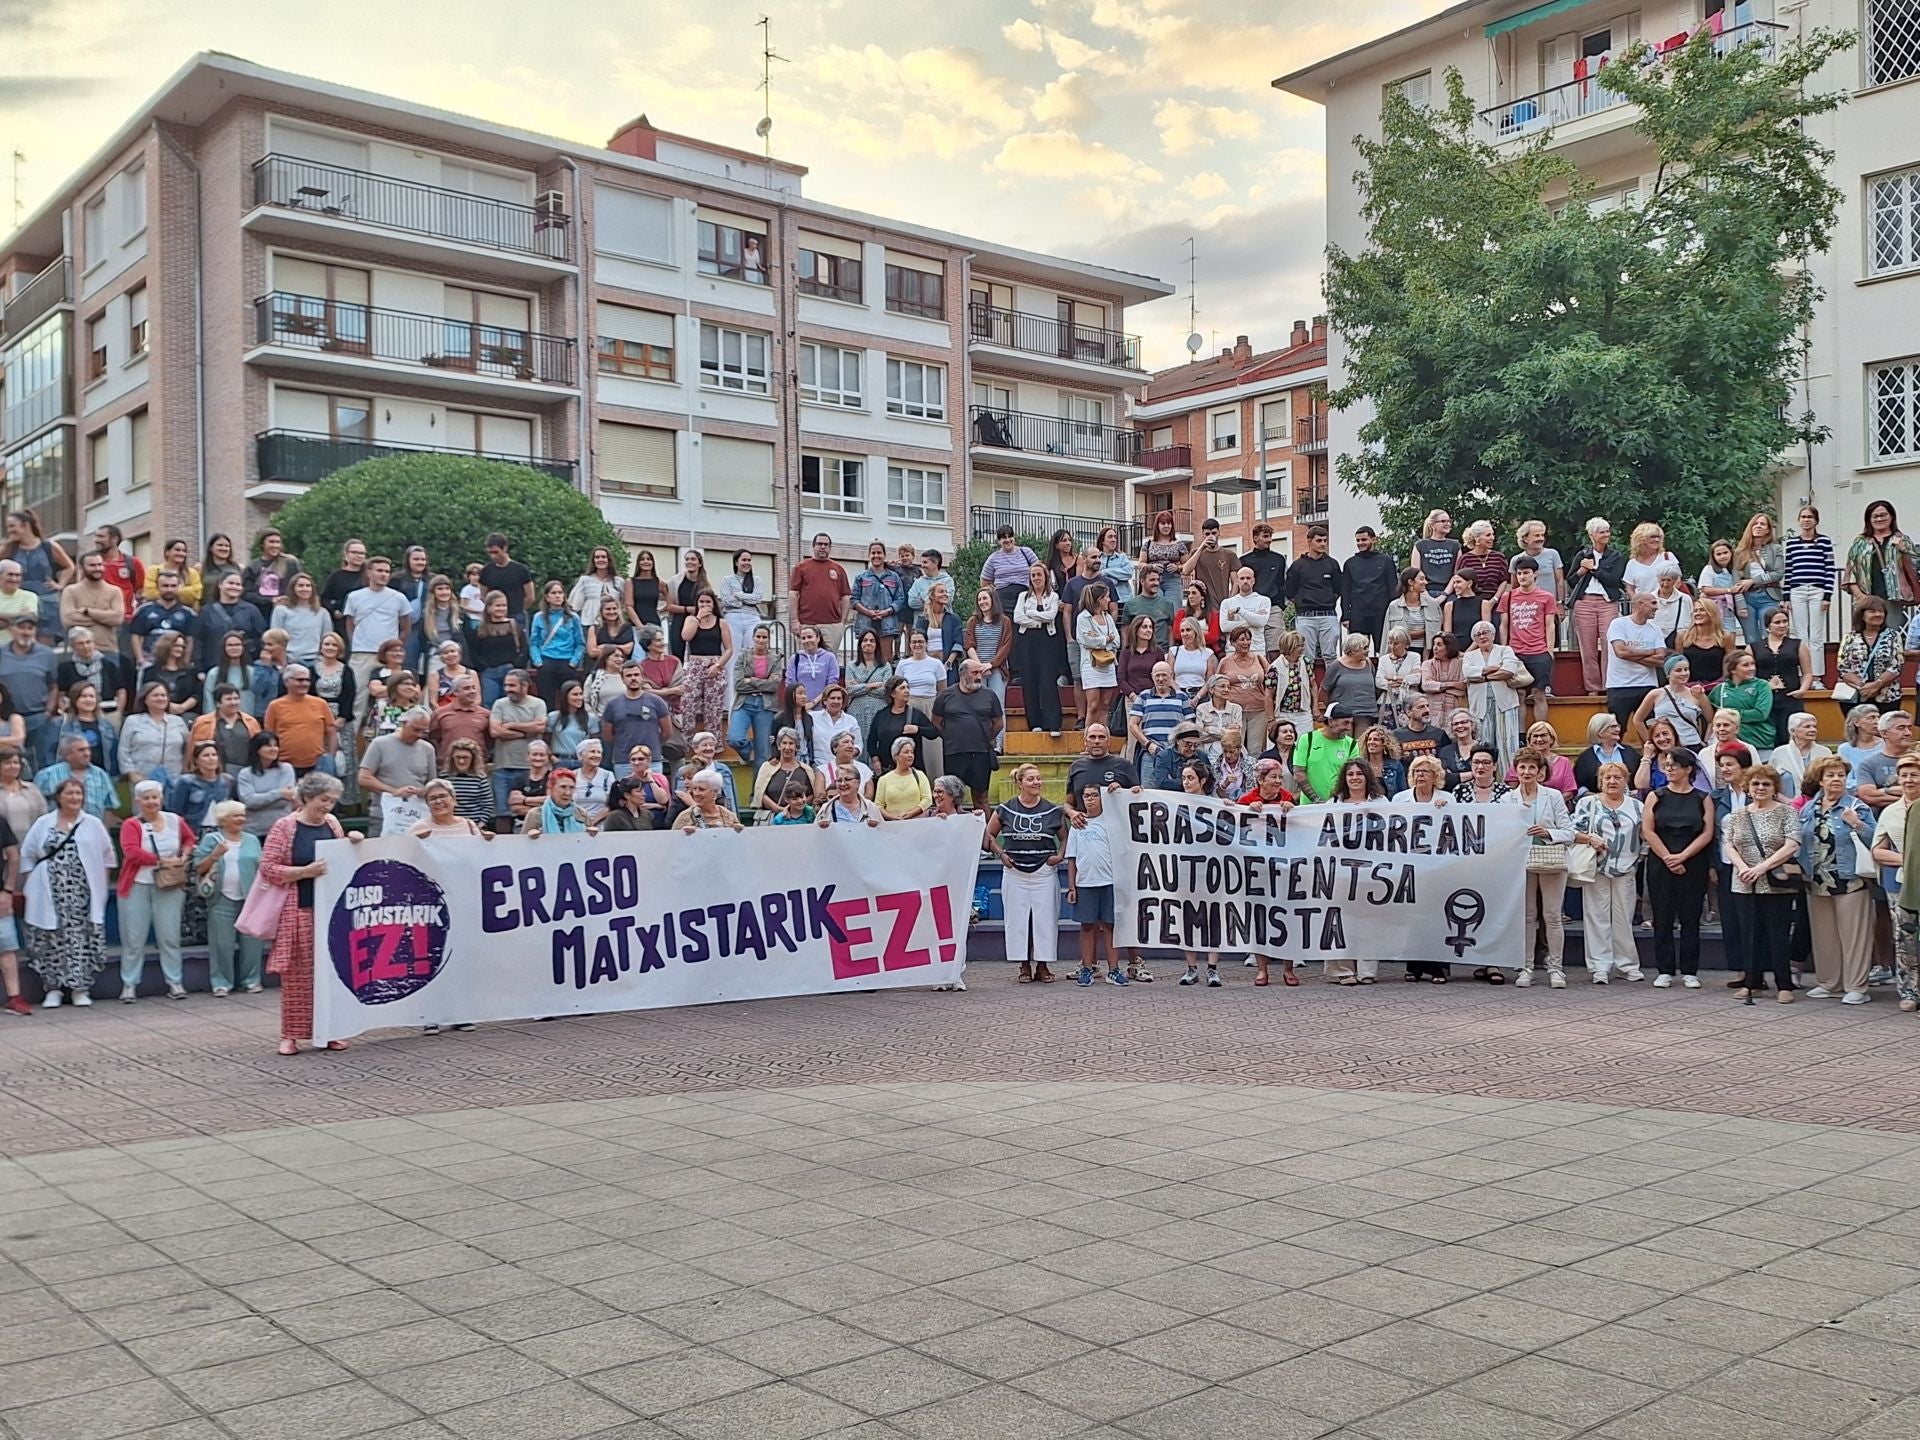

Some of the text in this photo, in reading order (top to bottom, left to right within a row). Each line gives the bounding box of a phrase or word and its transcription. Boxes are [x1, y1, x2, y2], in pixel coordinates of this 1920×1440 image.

[1129, 802, 1486, 856] ERASOEN AURREAN
[346, 885, 383, 910] ERASO
[481, 855, 639, 934] ERASO
[1137, 853, 1416, 905] AUTODEFENTSA
[552, 883, 957, 990] MATXISTARIK EZ!
[1137, 897, 1346, 950] FEMINISTA
[349, 922, 431, 990] EZ!
